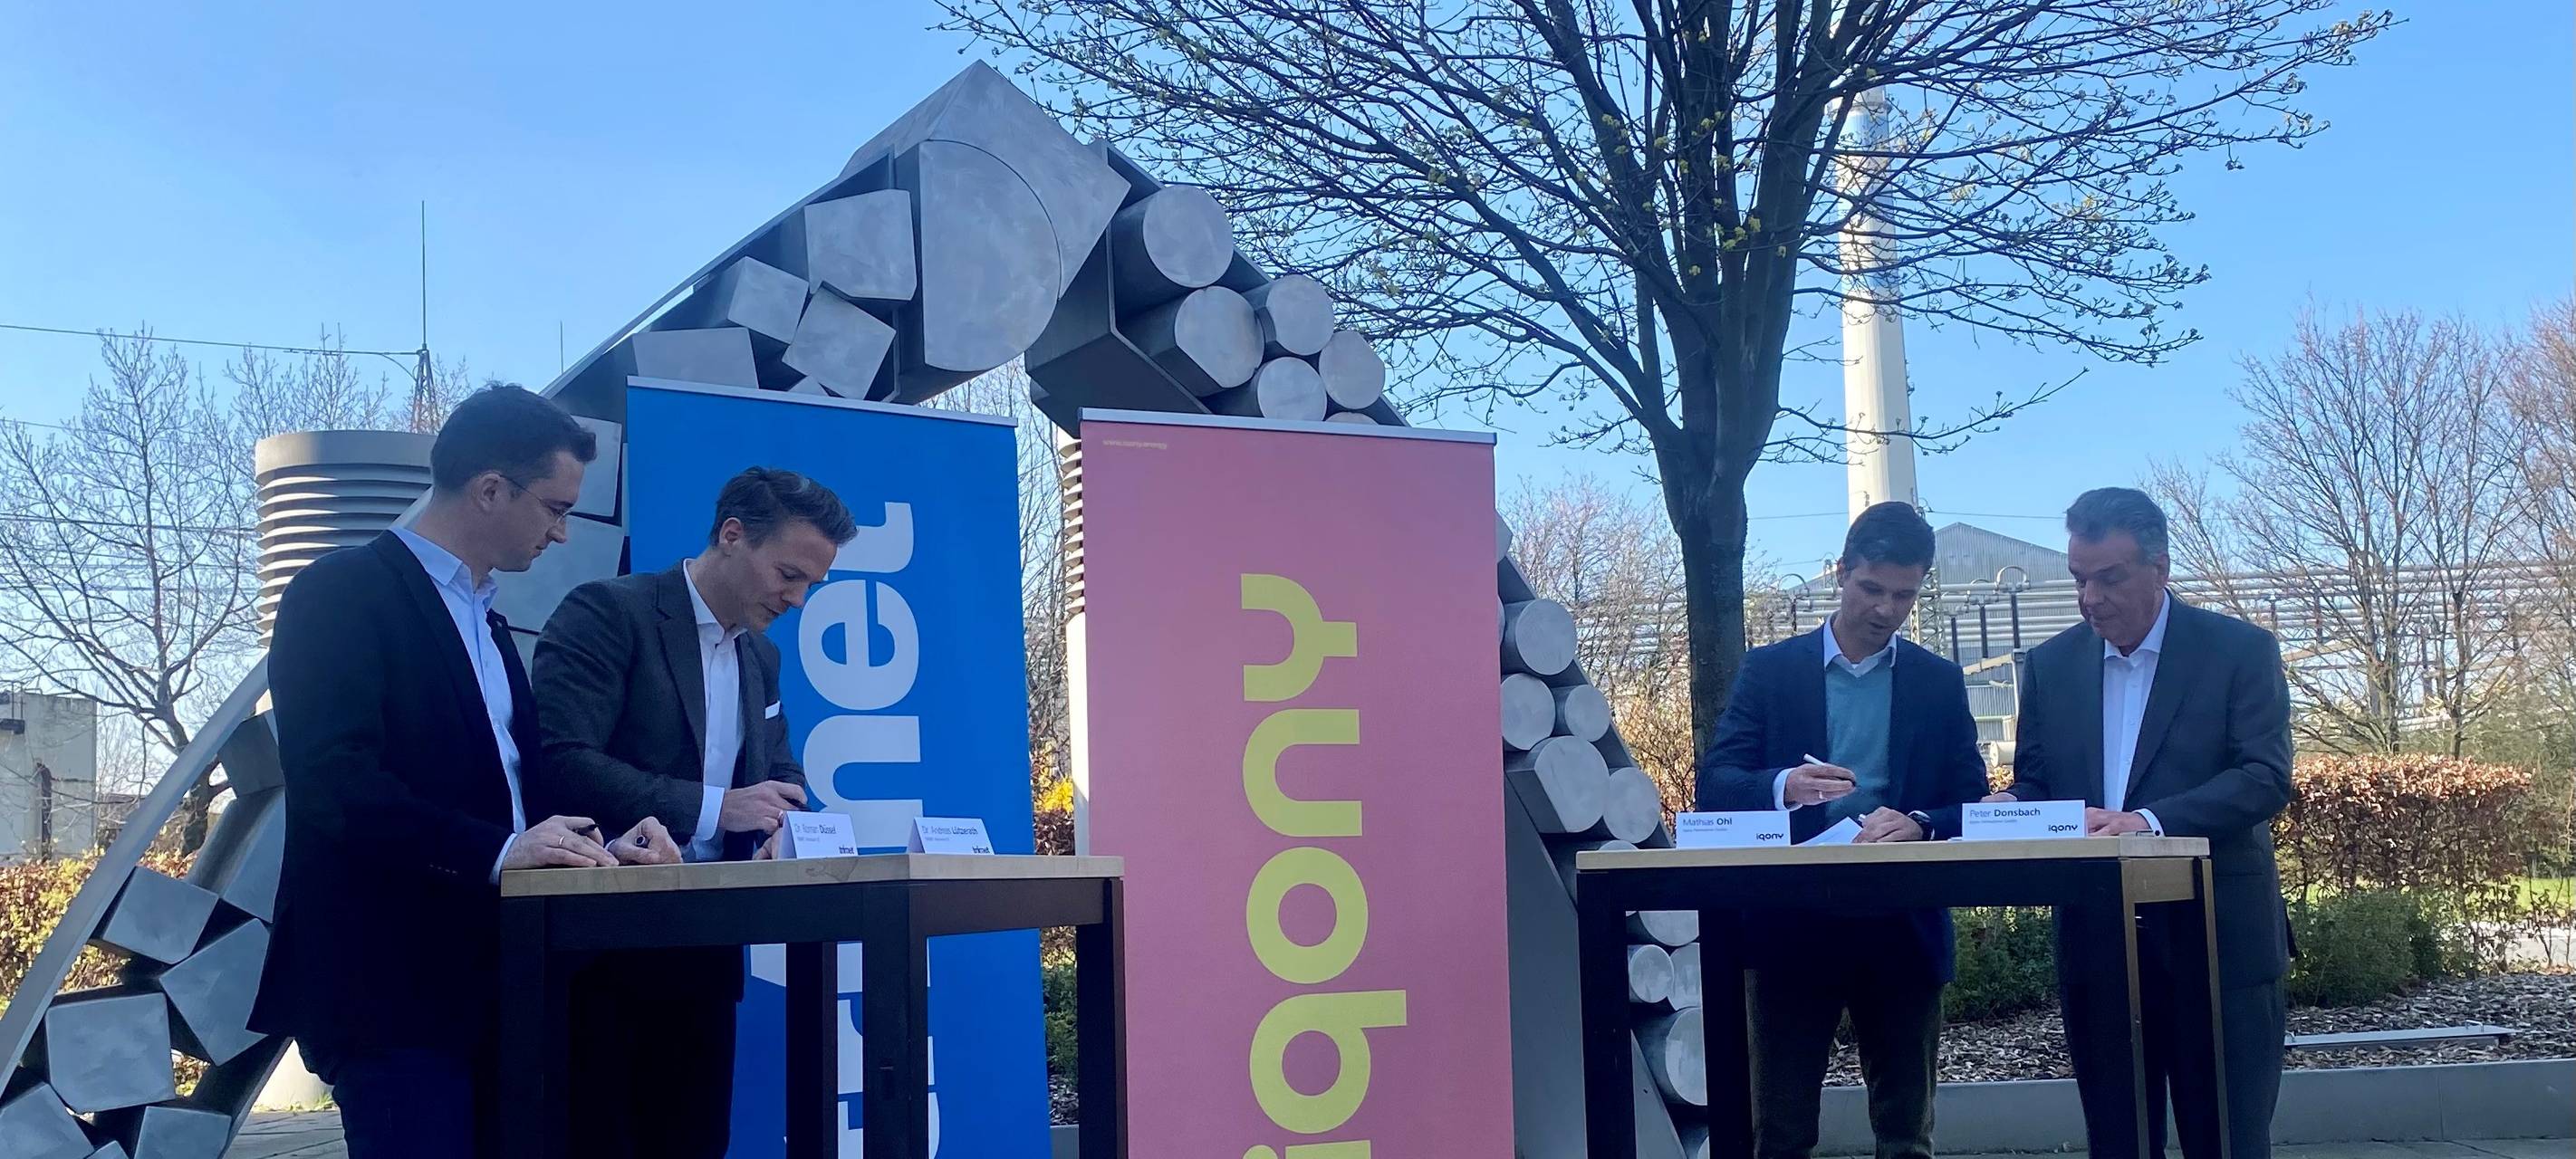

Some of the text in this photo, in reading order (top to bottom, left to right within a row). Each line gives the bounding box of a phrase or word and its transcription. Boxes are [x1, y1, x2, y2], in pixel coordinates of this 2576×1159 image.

[1969, 808, 2041, 818] Peter Donsbach
[1716, 818, 1733, 826] Ohl
[2048, 824, 2078, 833] iqony
[1756, 833, 1784, 841] iqony
